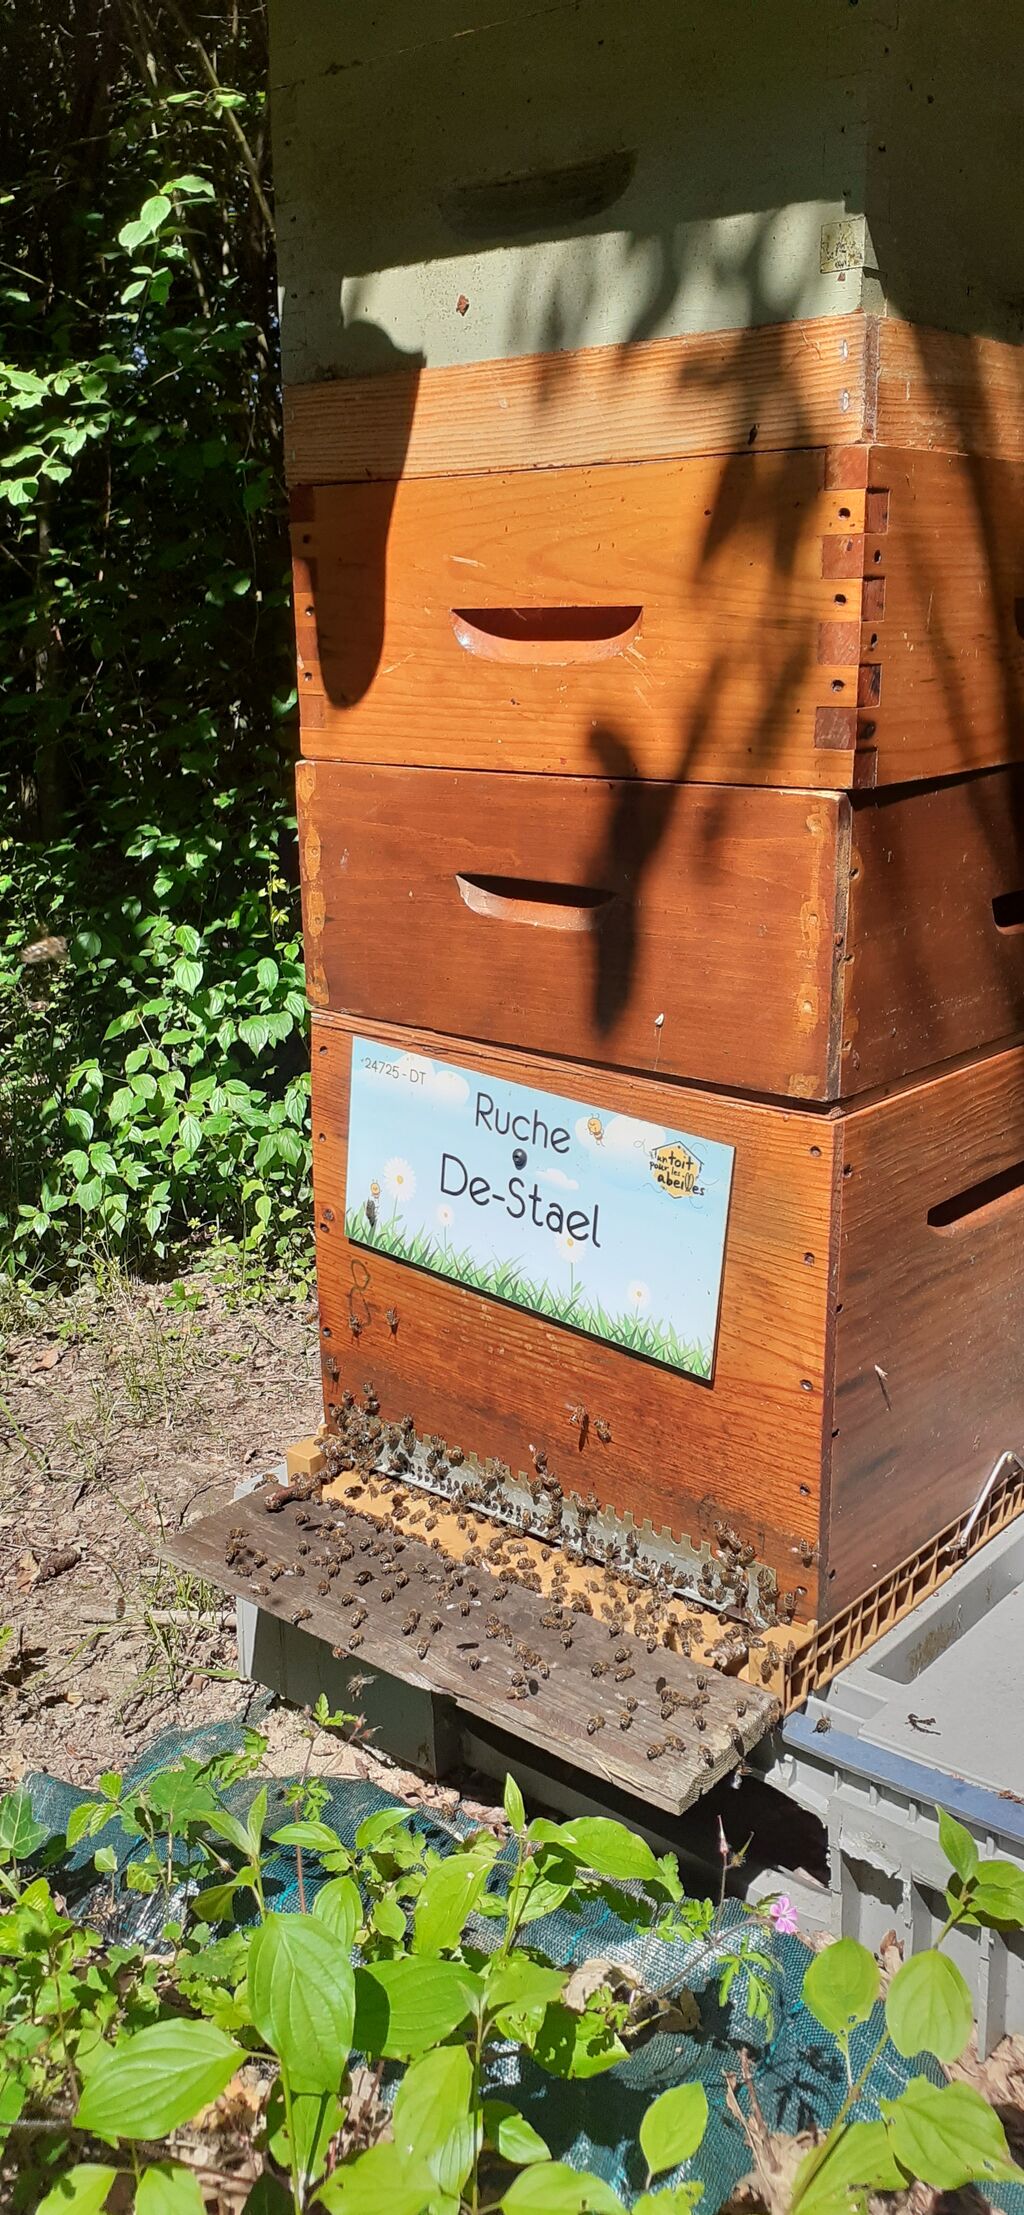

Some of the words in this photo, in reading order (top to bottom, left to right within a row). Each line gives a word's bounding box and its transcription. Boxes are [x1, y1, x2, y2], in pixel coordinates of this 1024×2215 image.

[364, 1057, 400, 1079] 24725
[475, 1091, 571, 1154] Ruche
[649, 1161, 669, 1171] pour
[671, 1166, 681, 1177] les
[668, 1150, 694, 1171] toit
[657, 1171, 705, 1196] abeilles
[440, 1152, 601, 1249] De-Stael
